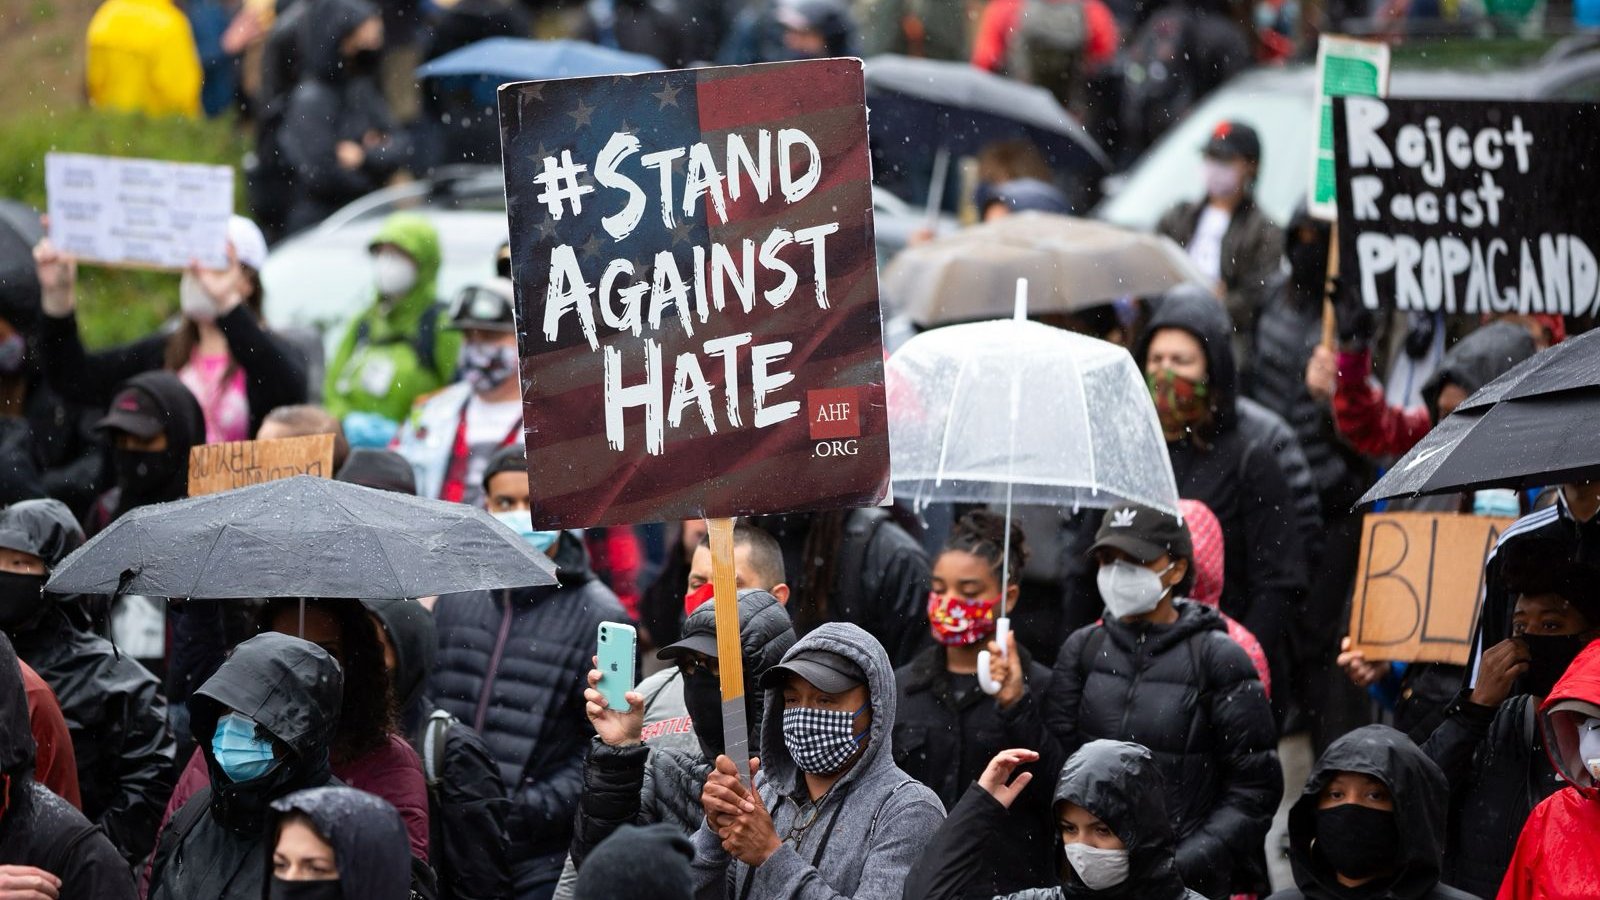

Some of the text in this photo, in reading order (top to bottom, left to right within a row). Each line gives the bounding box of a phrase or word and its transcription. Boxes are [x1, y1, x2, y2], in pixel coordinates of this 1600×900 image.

[533, 128, 822, 242] #STAND
[1344, 97, 1534, 188] Reject
[1351, 171, 1504, 228] Racist
[543, 222, 840, 352] AGAINST
[1356, 232, 1600, 318] PROPAGAND
[604, 332, 801, 456] HATE
[816, 402, 850, 422] AHF
[811, 439, 859, 458] .ORG
